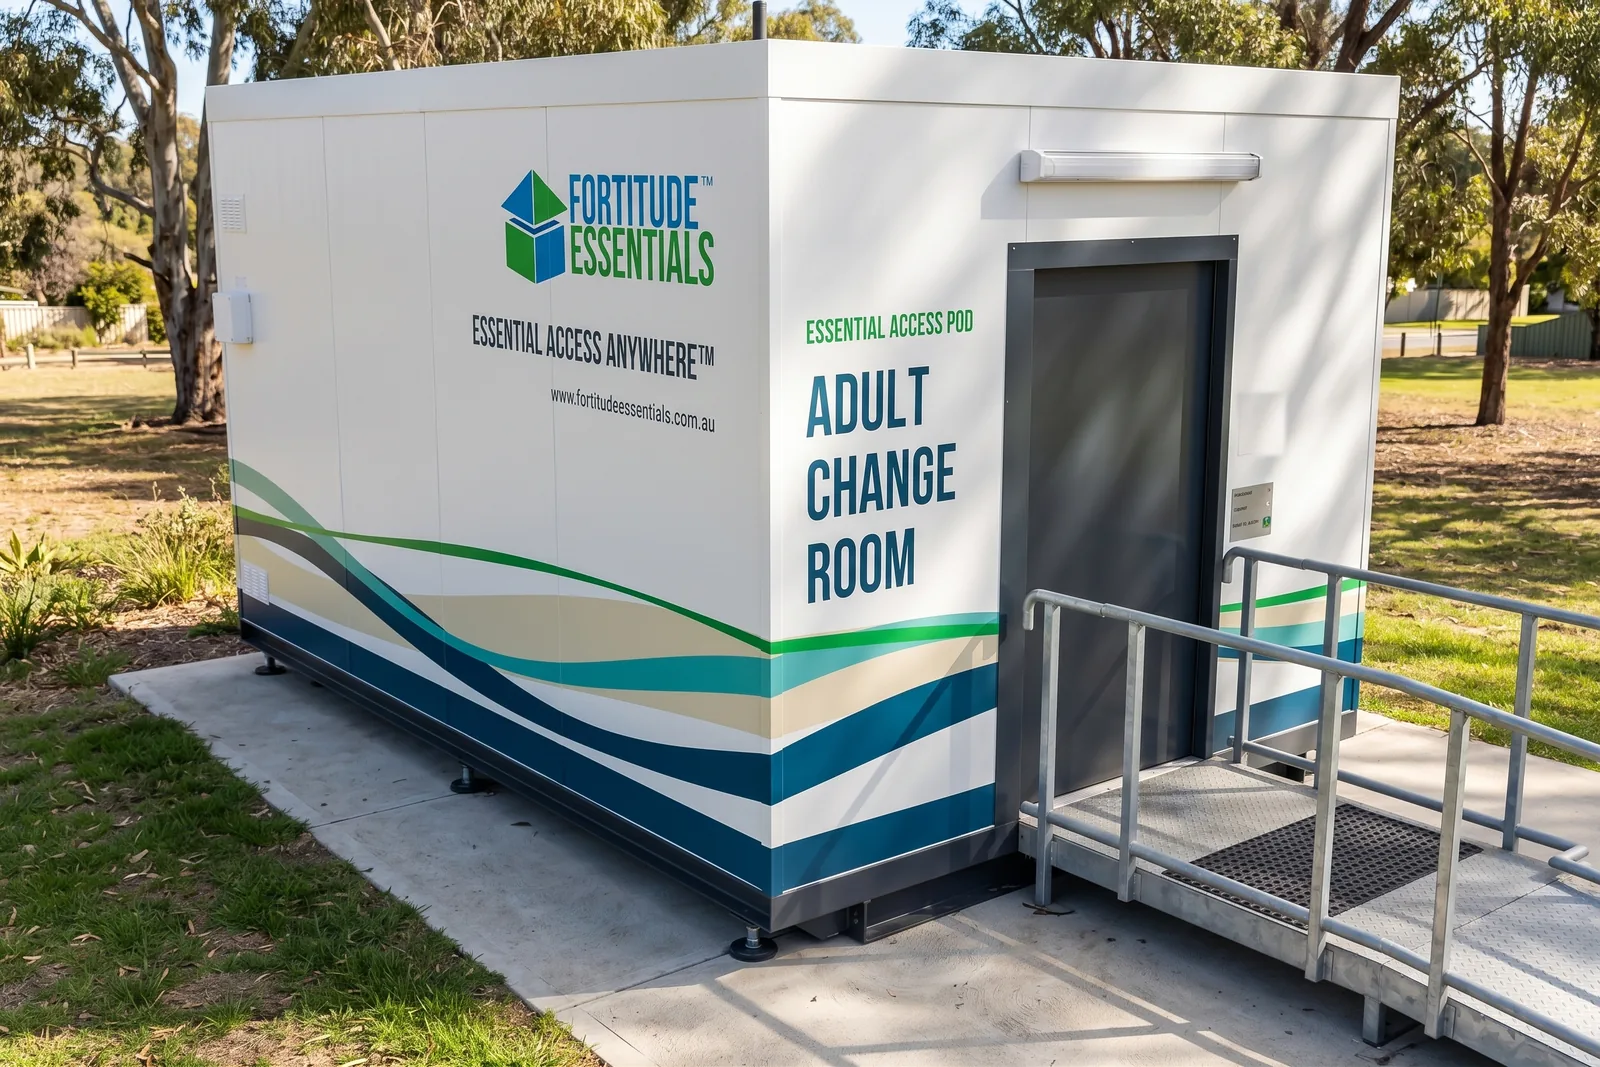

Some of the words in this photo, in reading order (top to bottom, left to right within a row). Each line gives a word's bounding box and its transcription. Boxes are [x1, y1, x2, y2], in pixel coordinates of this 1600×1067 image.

[570, 225, 715, 287] ESSENTIALS
[472, 314, 543, 356] ESSENTIAL
[546, 324, 602, 365] ACCESS
[806, 315, 886, 345] ESSENTIAL
[889, 312, 944, 339] ACCESS
[946, 309, 974, 334] POD
[550, 388, 715, 433] www.fortitudeessentials.com.au
[807, 365, 930, 438] ADULT
[807, 442, 957, 522] CHANGE
[807, 527, 915, 604] ROOM
